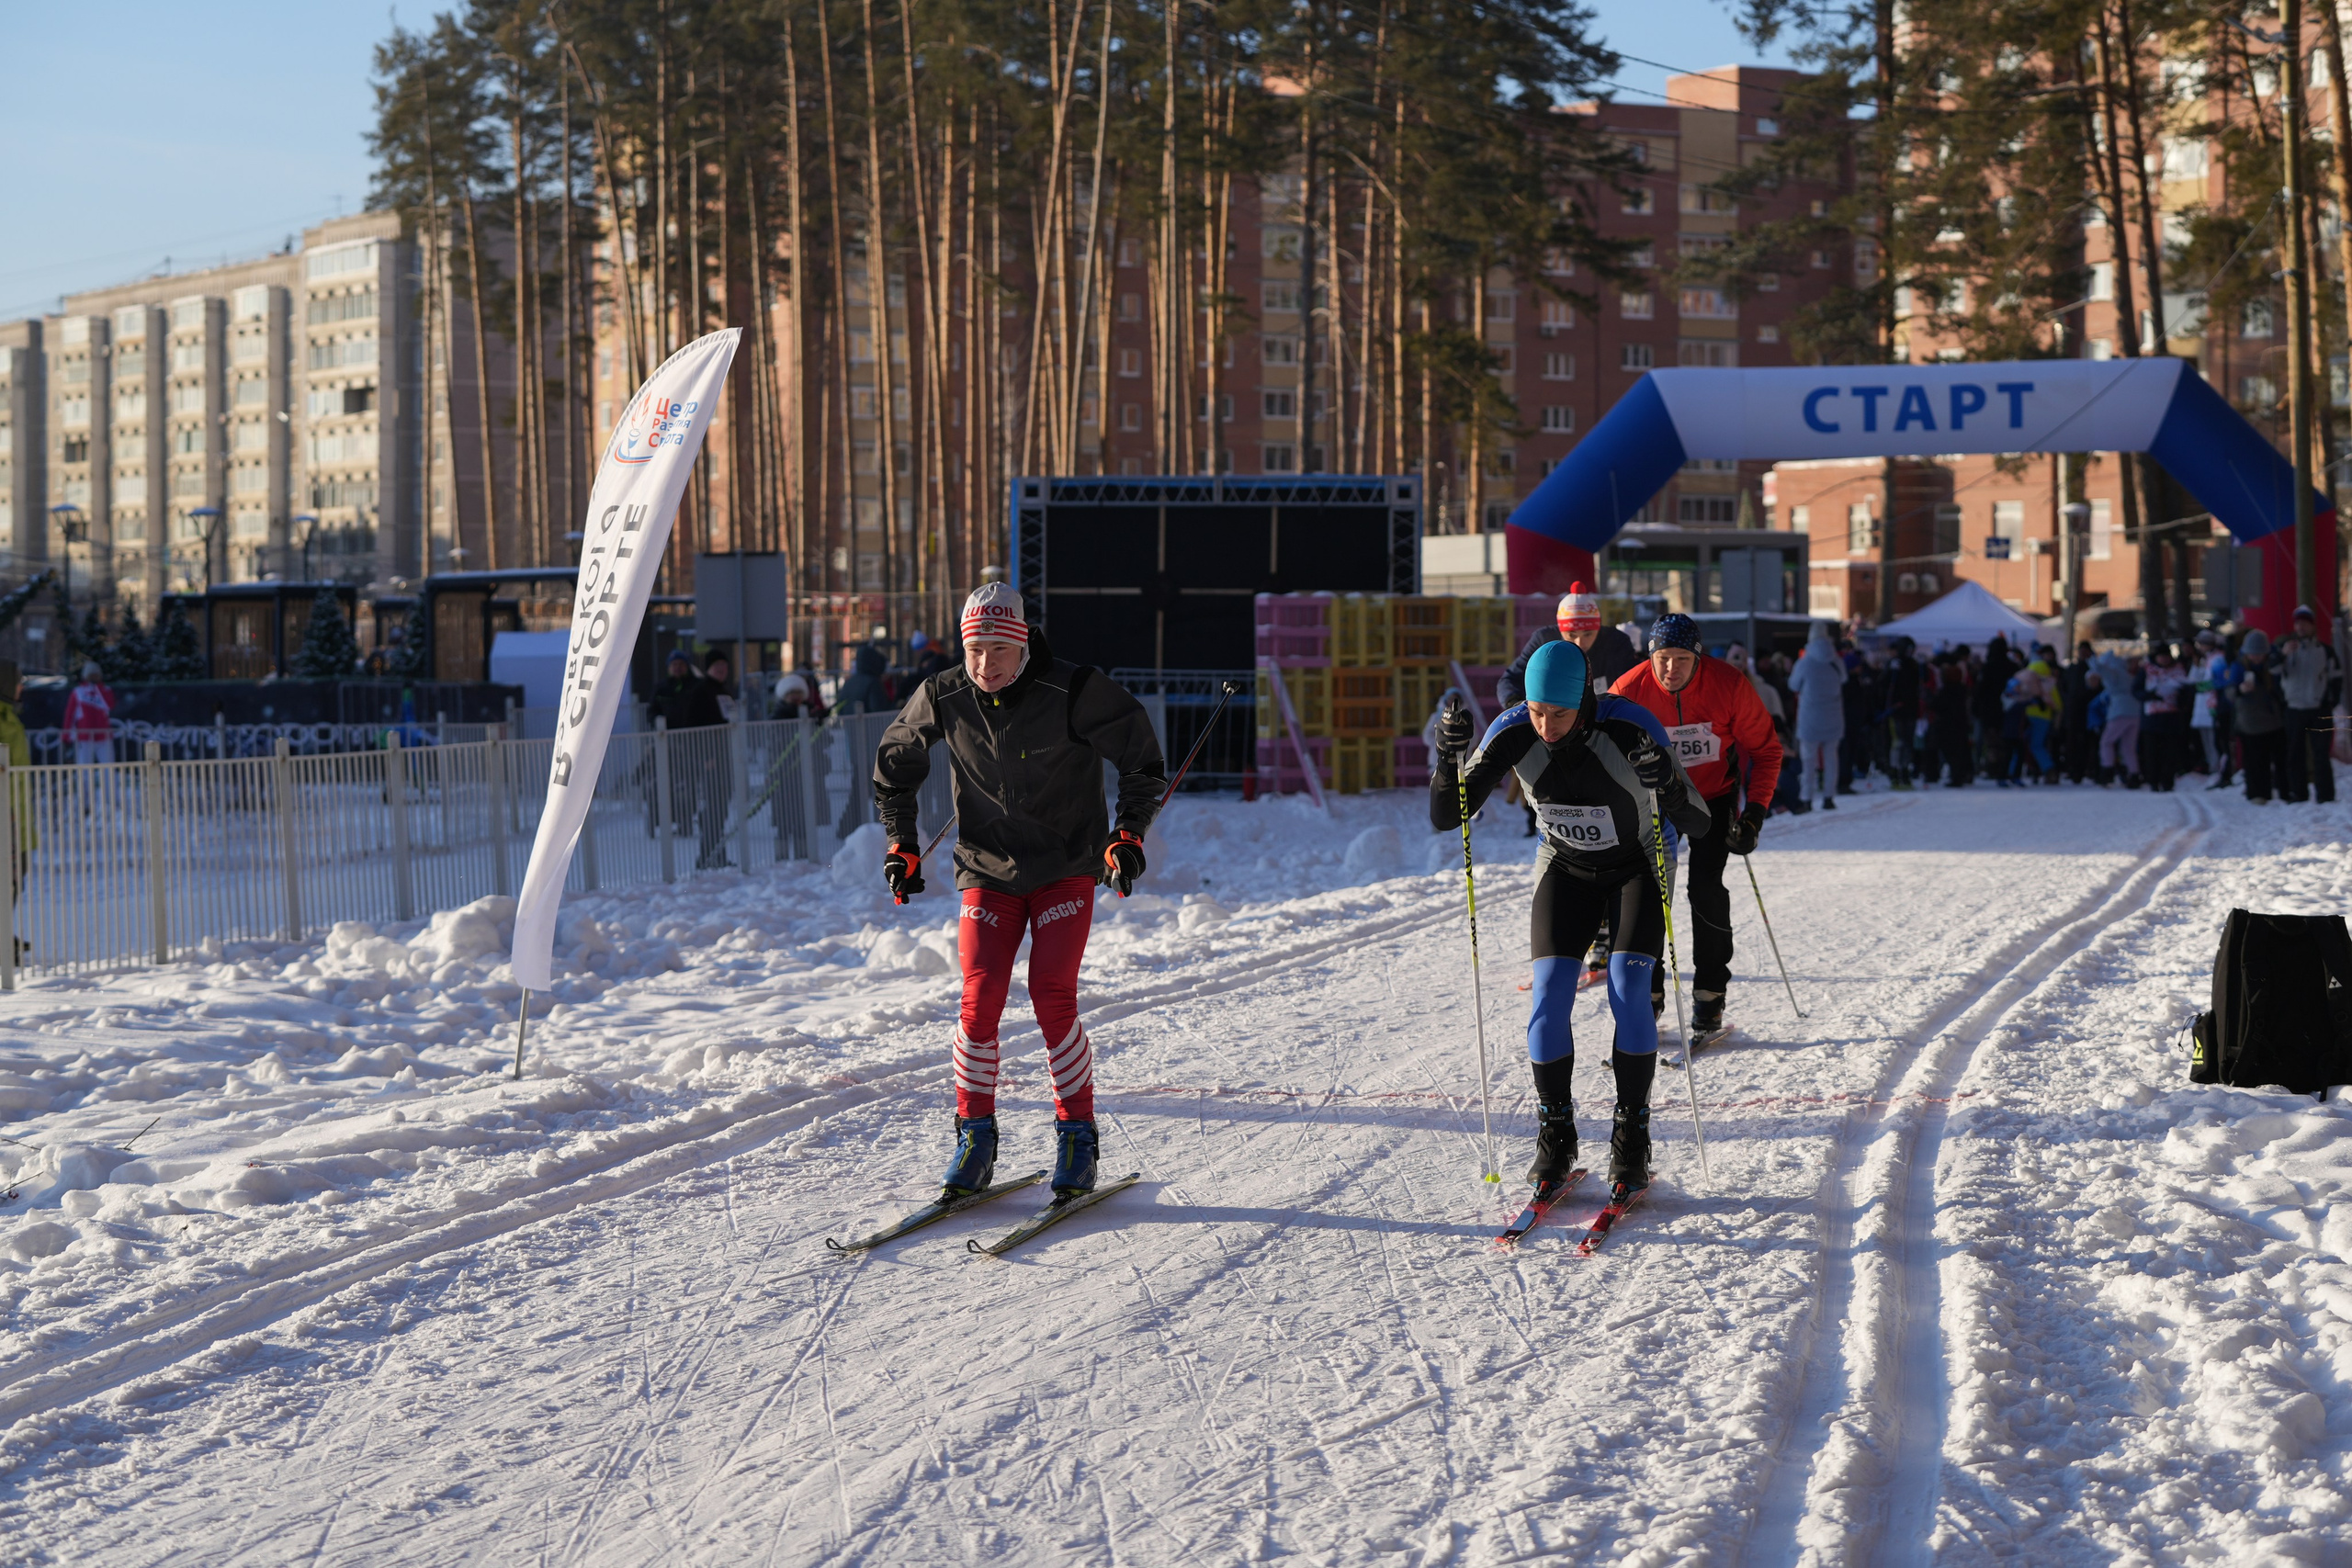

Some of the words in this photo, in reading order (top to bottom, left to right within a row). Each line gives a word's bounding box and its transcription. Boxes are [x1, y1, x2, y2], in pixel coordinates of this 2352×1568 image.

[656, 397, 698, 420] Цетр
[1802, 381, 2035, 434] СТАРТ
[570, 503, 649, 728] СПОРТЕ
[966, 605, 1016, 619] LUKOIL
[1671, 739, 1711, 755] 7561
[1544, 821, 1601, 841] 7009
[1036, 899, 1079, 930] BOSCO
[949, 1195, 980, 1213] FISCHER
[1065, 1195, 1090, 1213] FISCHER
